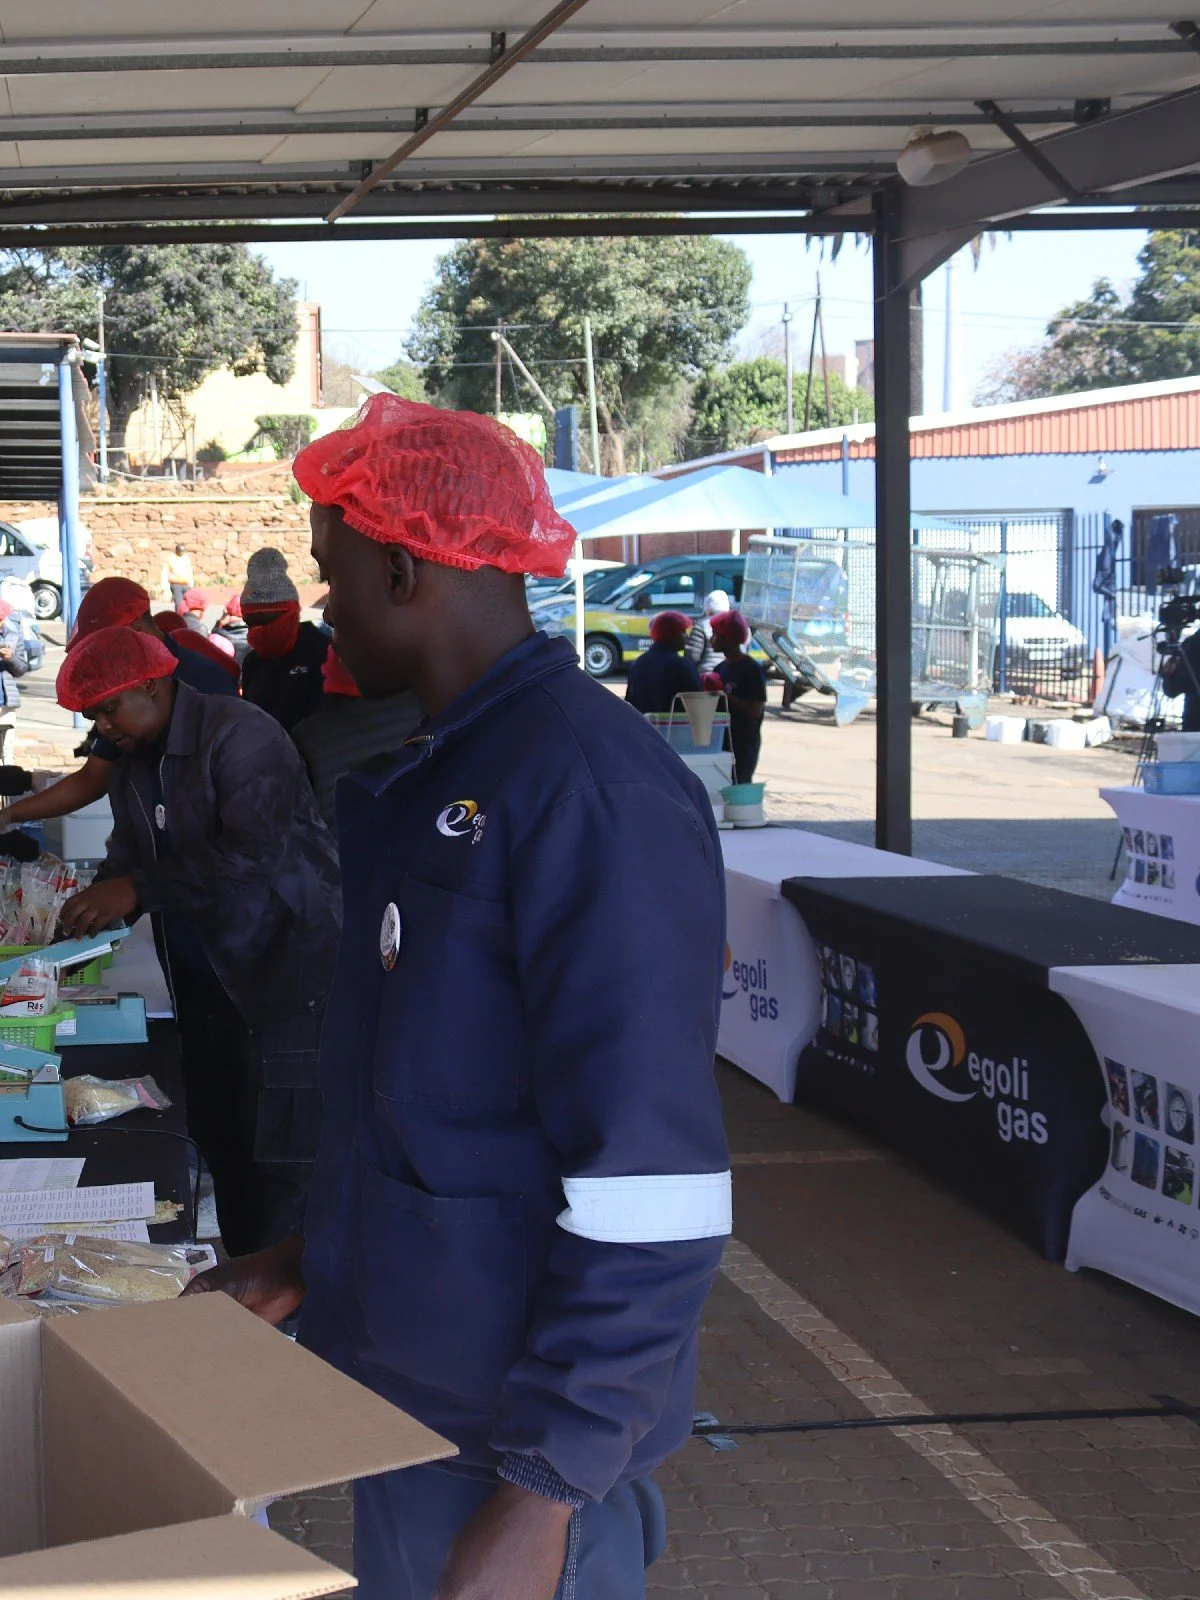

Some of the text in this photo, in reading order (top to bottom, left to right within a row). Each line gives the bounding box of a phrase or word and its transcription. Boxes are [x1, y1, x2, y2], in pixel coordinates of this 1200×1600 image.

[733, 959, 767, 992] egoli
[750, 993, 779, 1022] gas
[968, 1052, 1028, 1101] egoli
[997, 1101, 1049, 1145] gas
